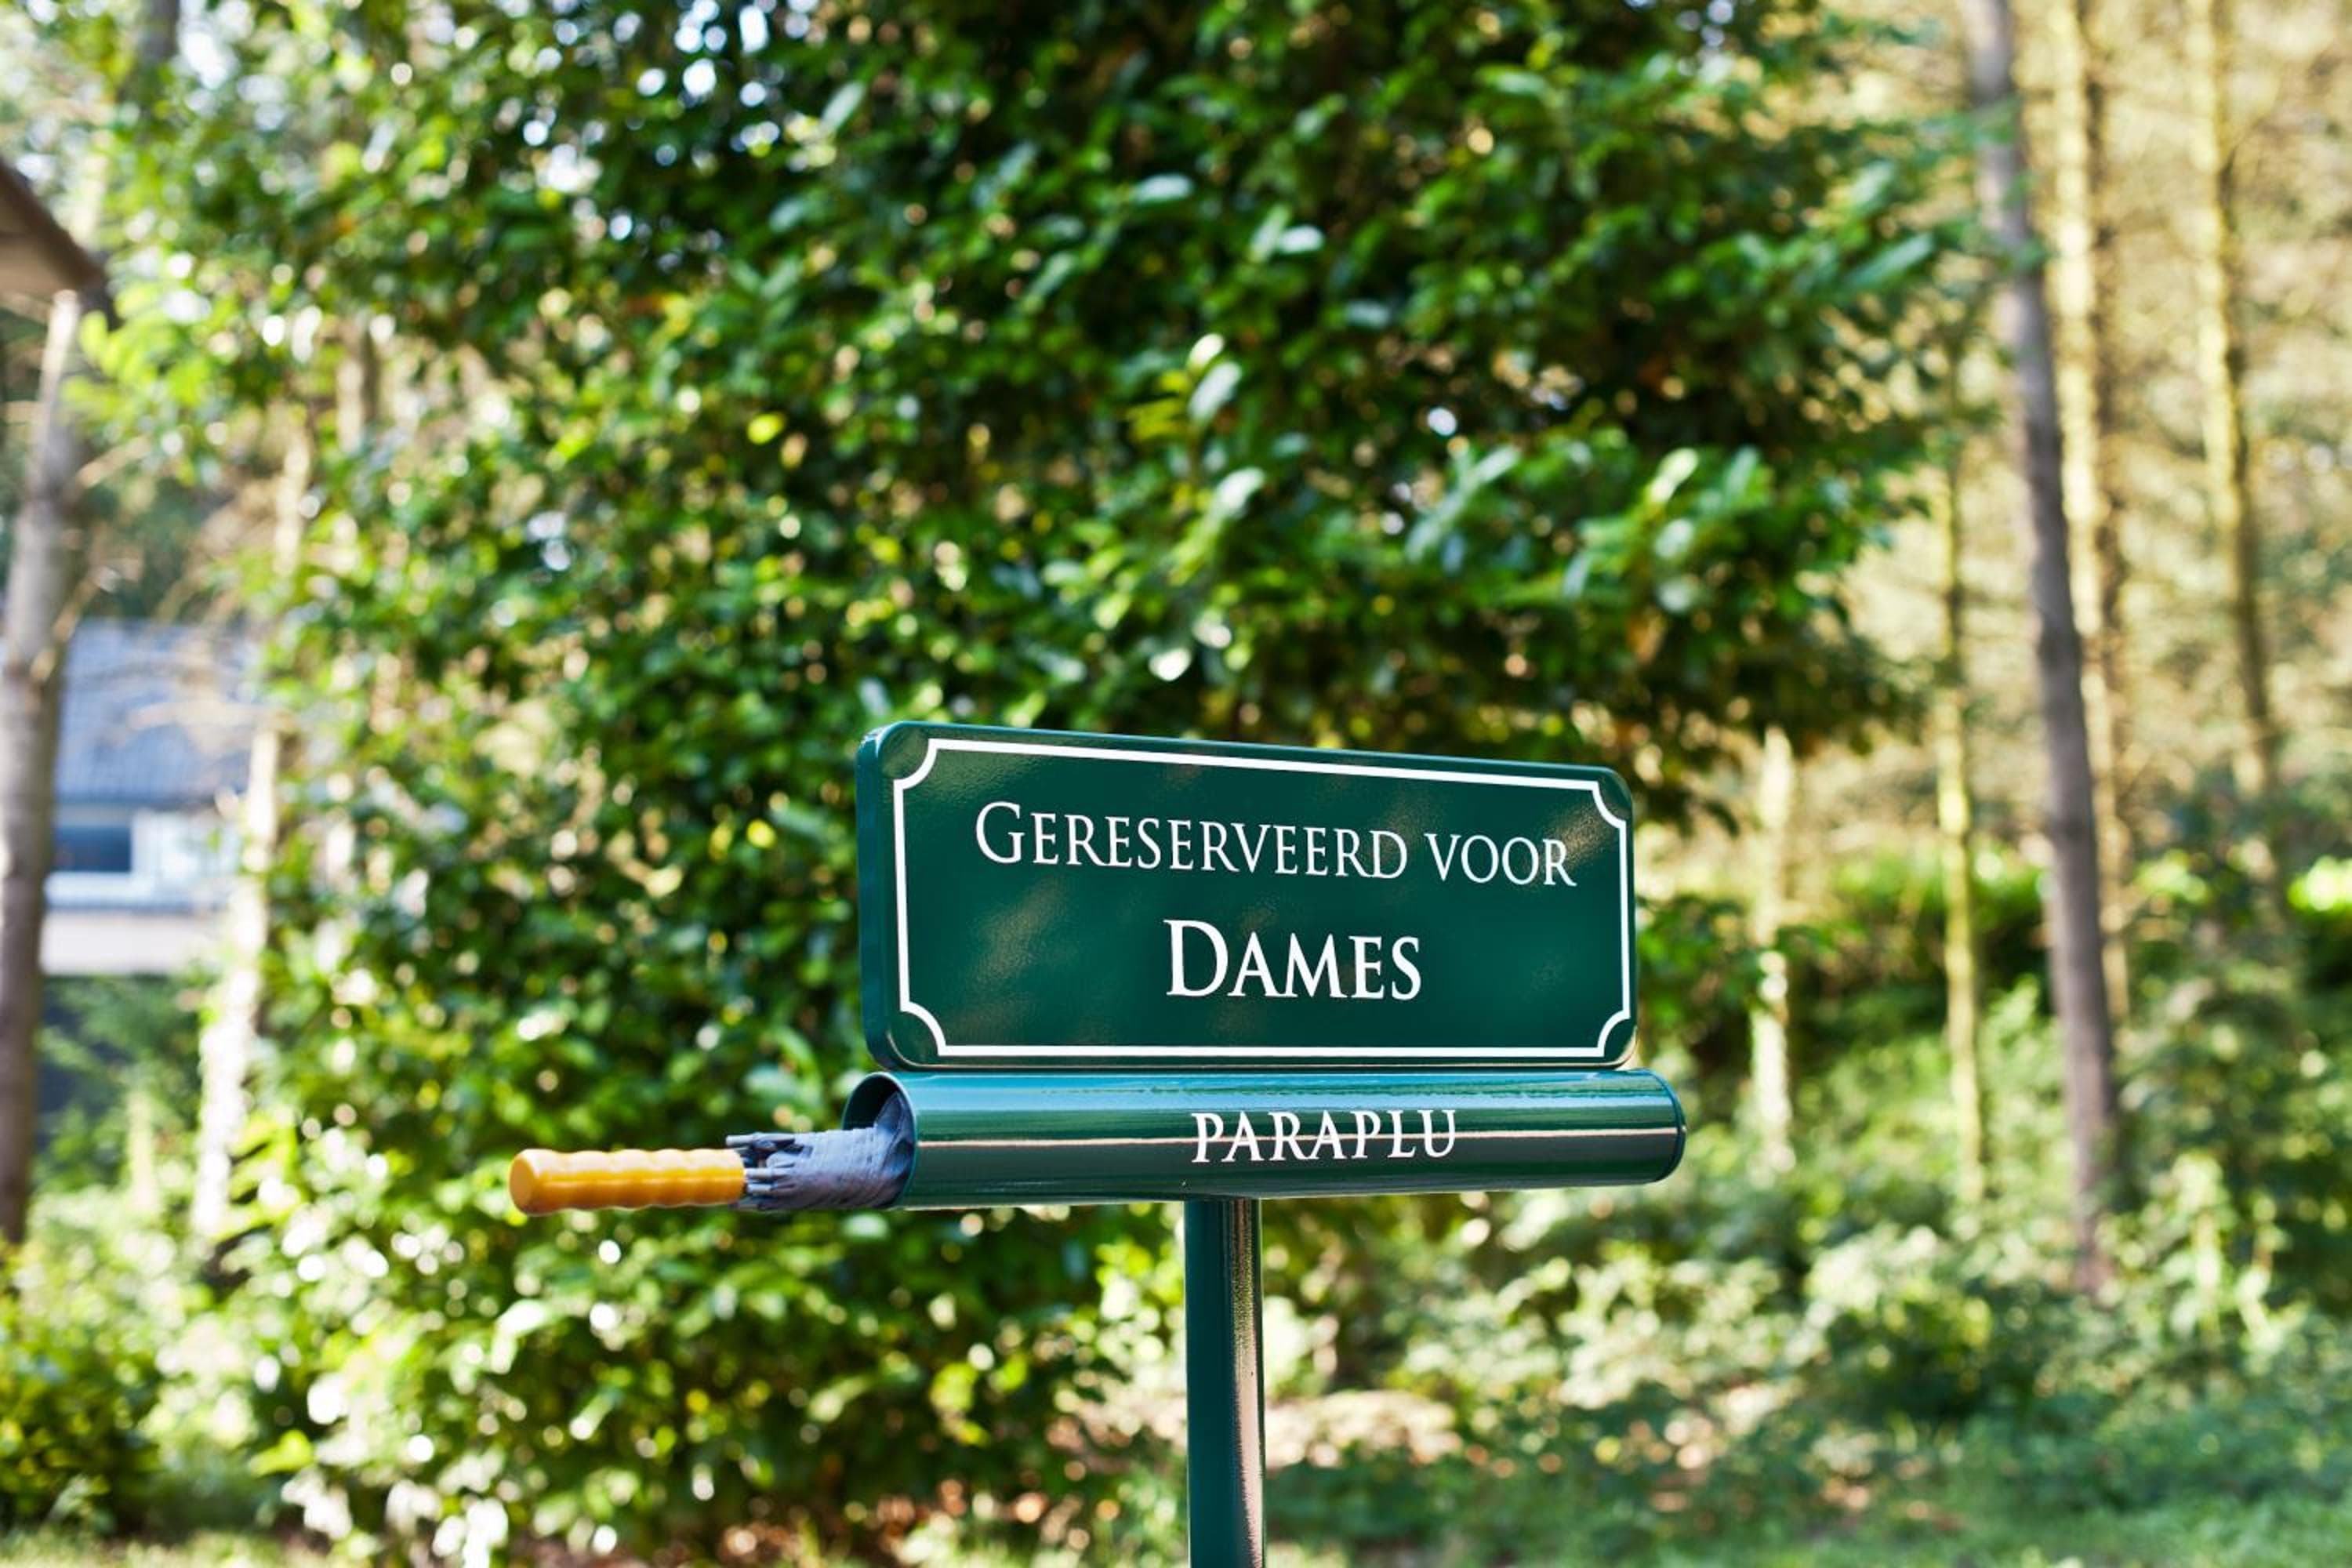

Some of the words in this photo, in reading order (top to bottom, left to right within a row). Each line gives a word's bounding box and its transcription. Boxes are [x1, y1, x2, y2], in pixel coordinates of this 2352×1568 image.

[975, 801, 1407, 879] GERESERVEERD
[1424, 833, 1577, 887] VOOR
[1164, 920, 1421, 1000] DAMES
[1191, 1109, 1457, 1163] PARAPLU
